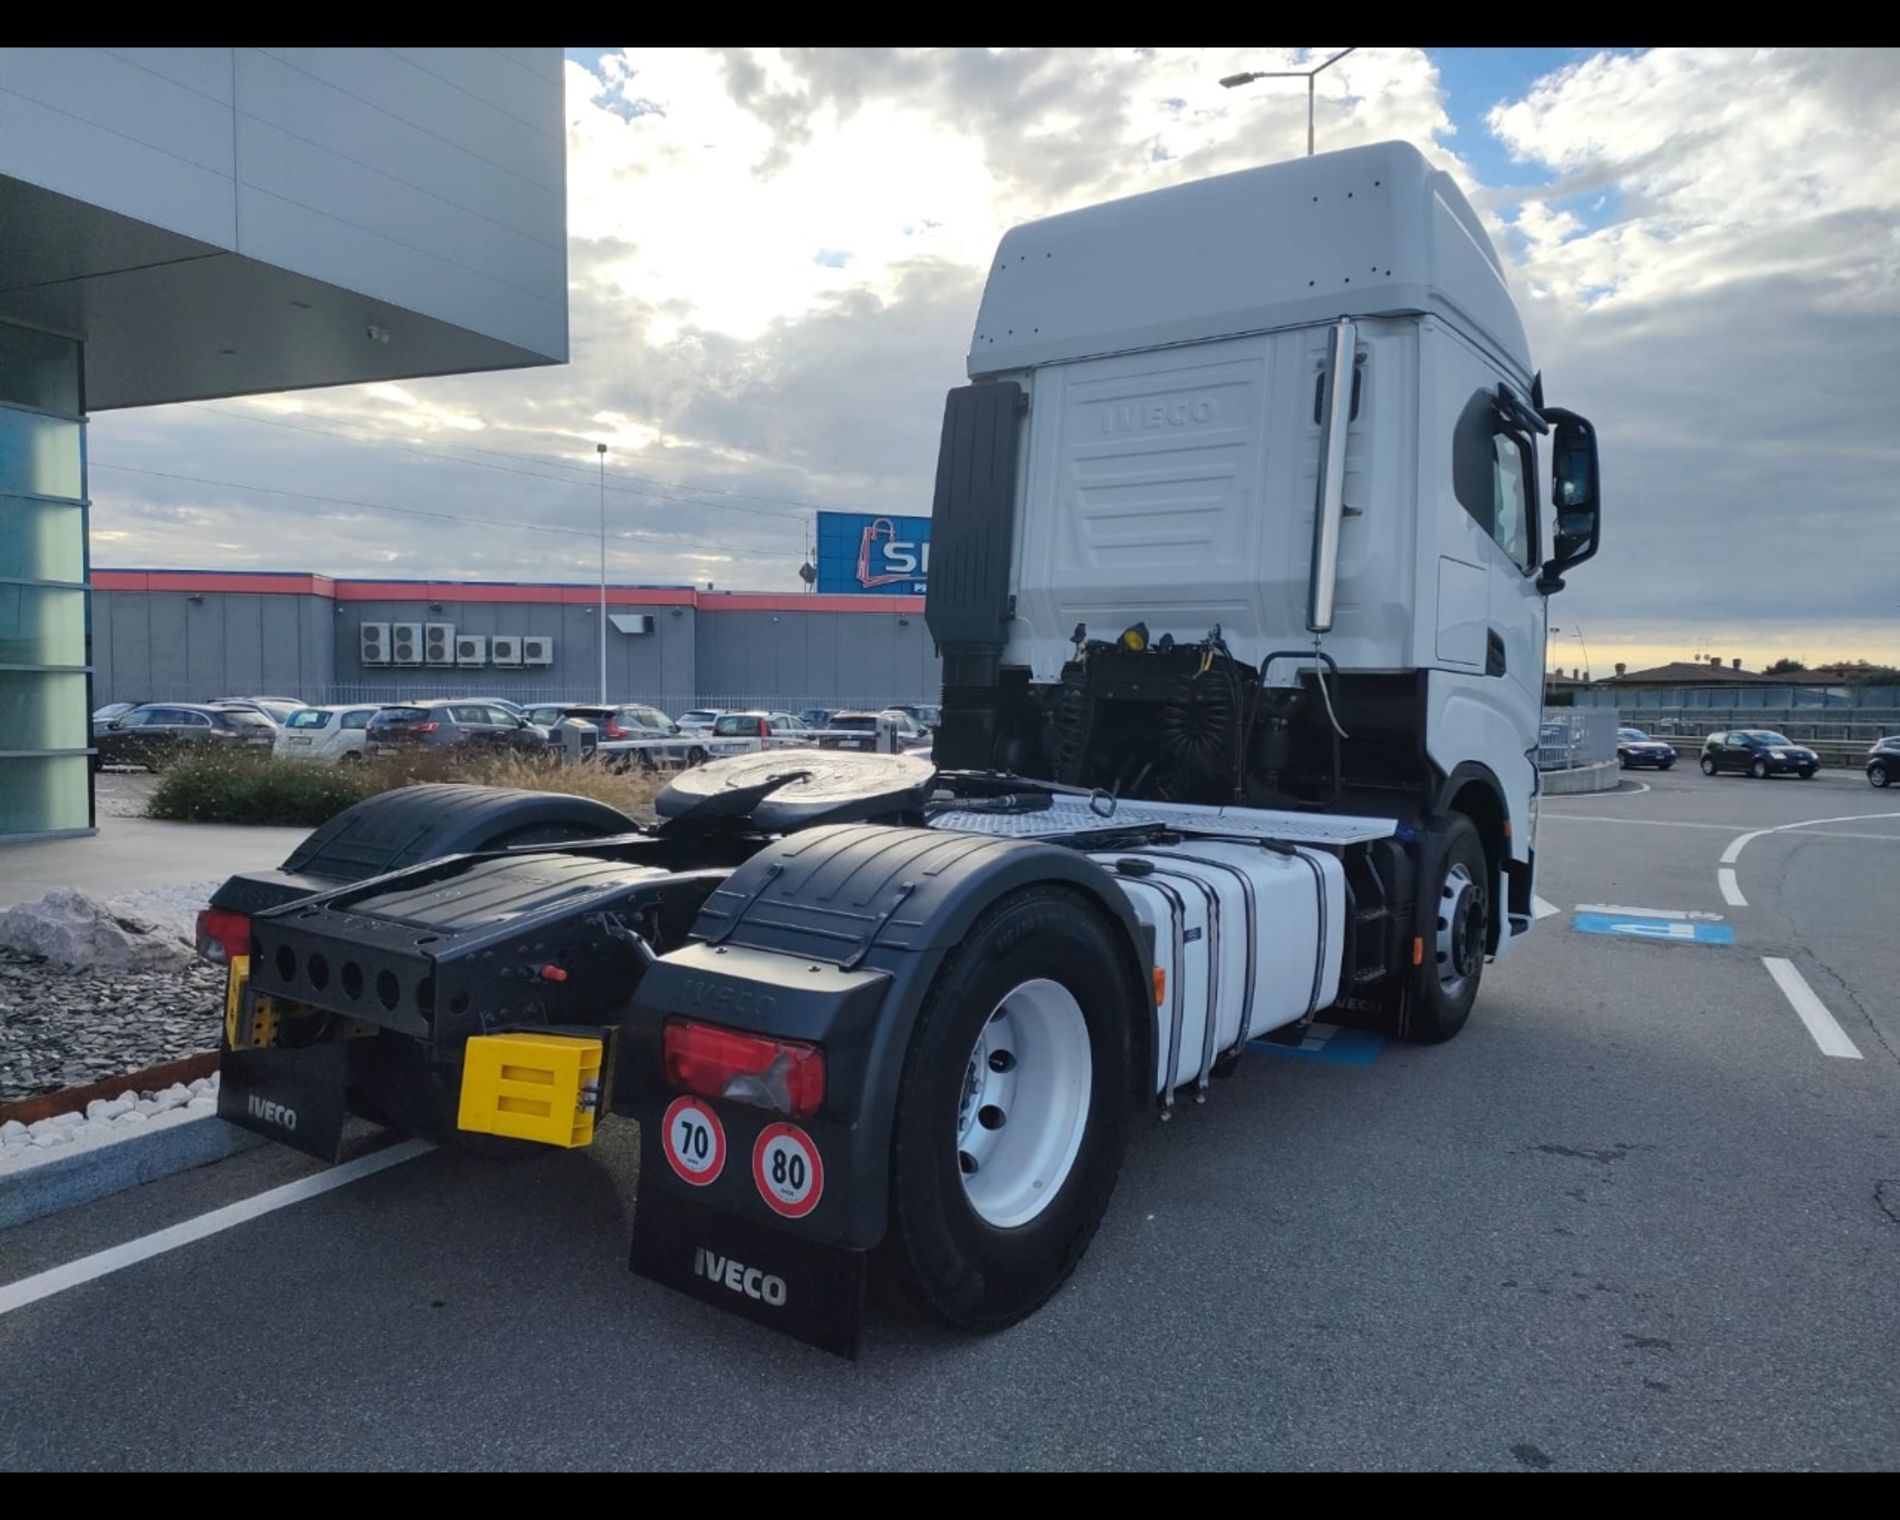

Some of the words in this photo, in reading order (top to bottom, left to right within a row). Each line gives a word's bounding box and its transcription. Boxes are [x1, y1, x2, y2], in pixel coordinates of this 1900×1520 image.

[1104, 399, 1215, 433] IVECO
[248, 1095, 297, 1130] IVECO
[681, 1120, 709, 1159] 70
[772, 1148, 805, 1190] 80
[694, 1247, 787, 1307] IVECO
